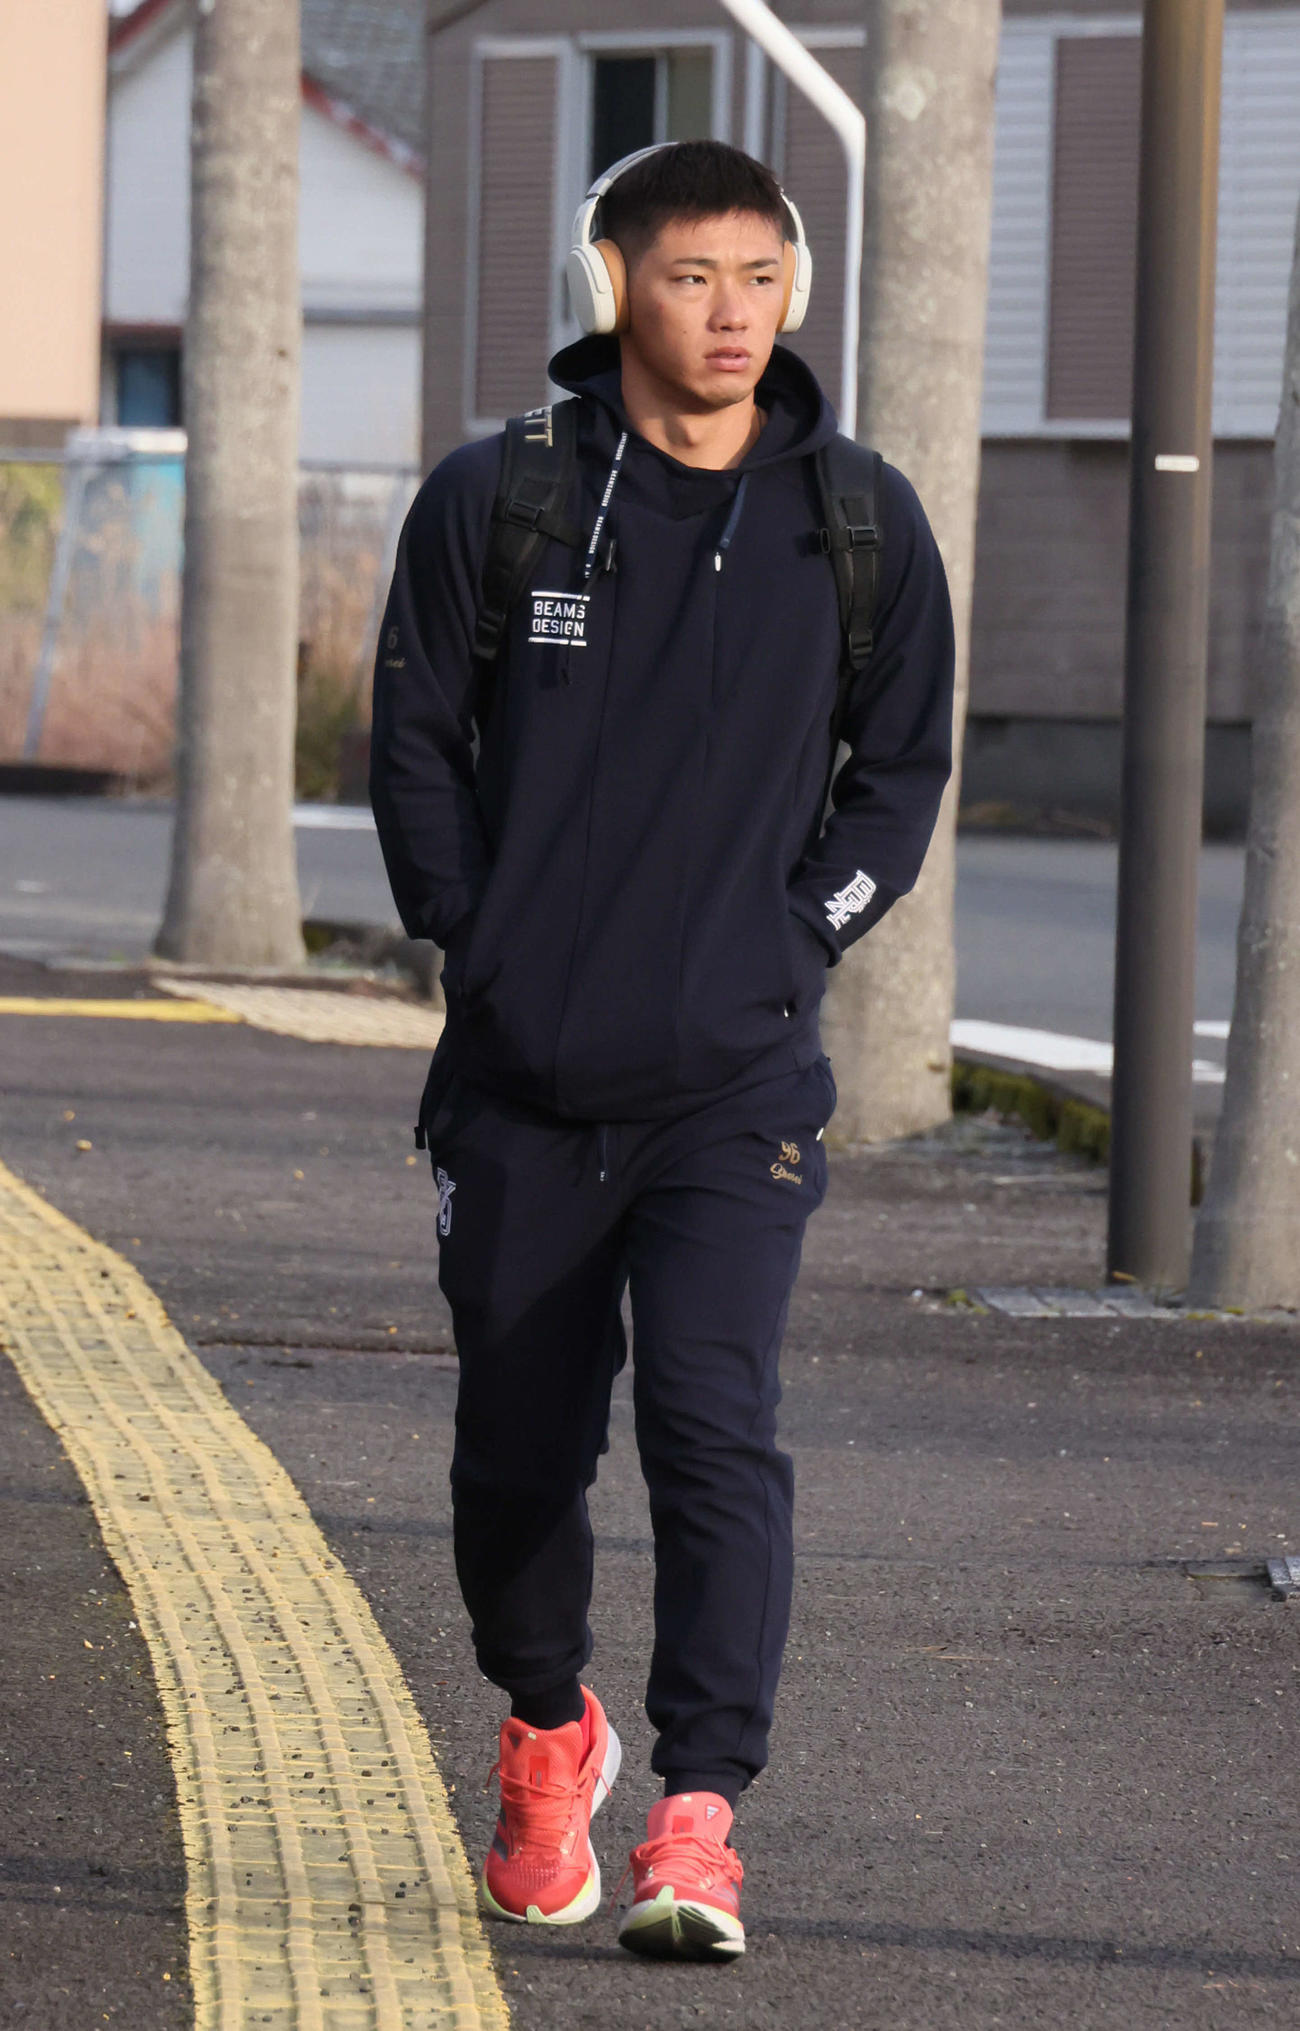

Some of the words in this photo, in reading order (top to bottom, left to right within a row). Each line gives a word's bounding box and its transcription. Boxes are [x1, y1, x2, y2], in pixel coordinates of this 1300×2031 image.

[533, 600, 586, 619] BEAMS
[532, 618, 584, 637] DESIGN
[778, 1140, 801, 1165] 96
